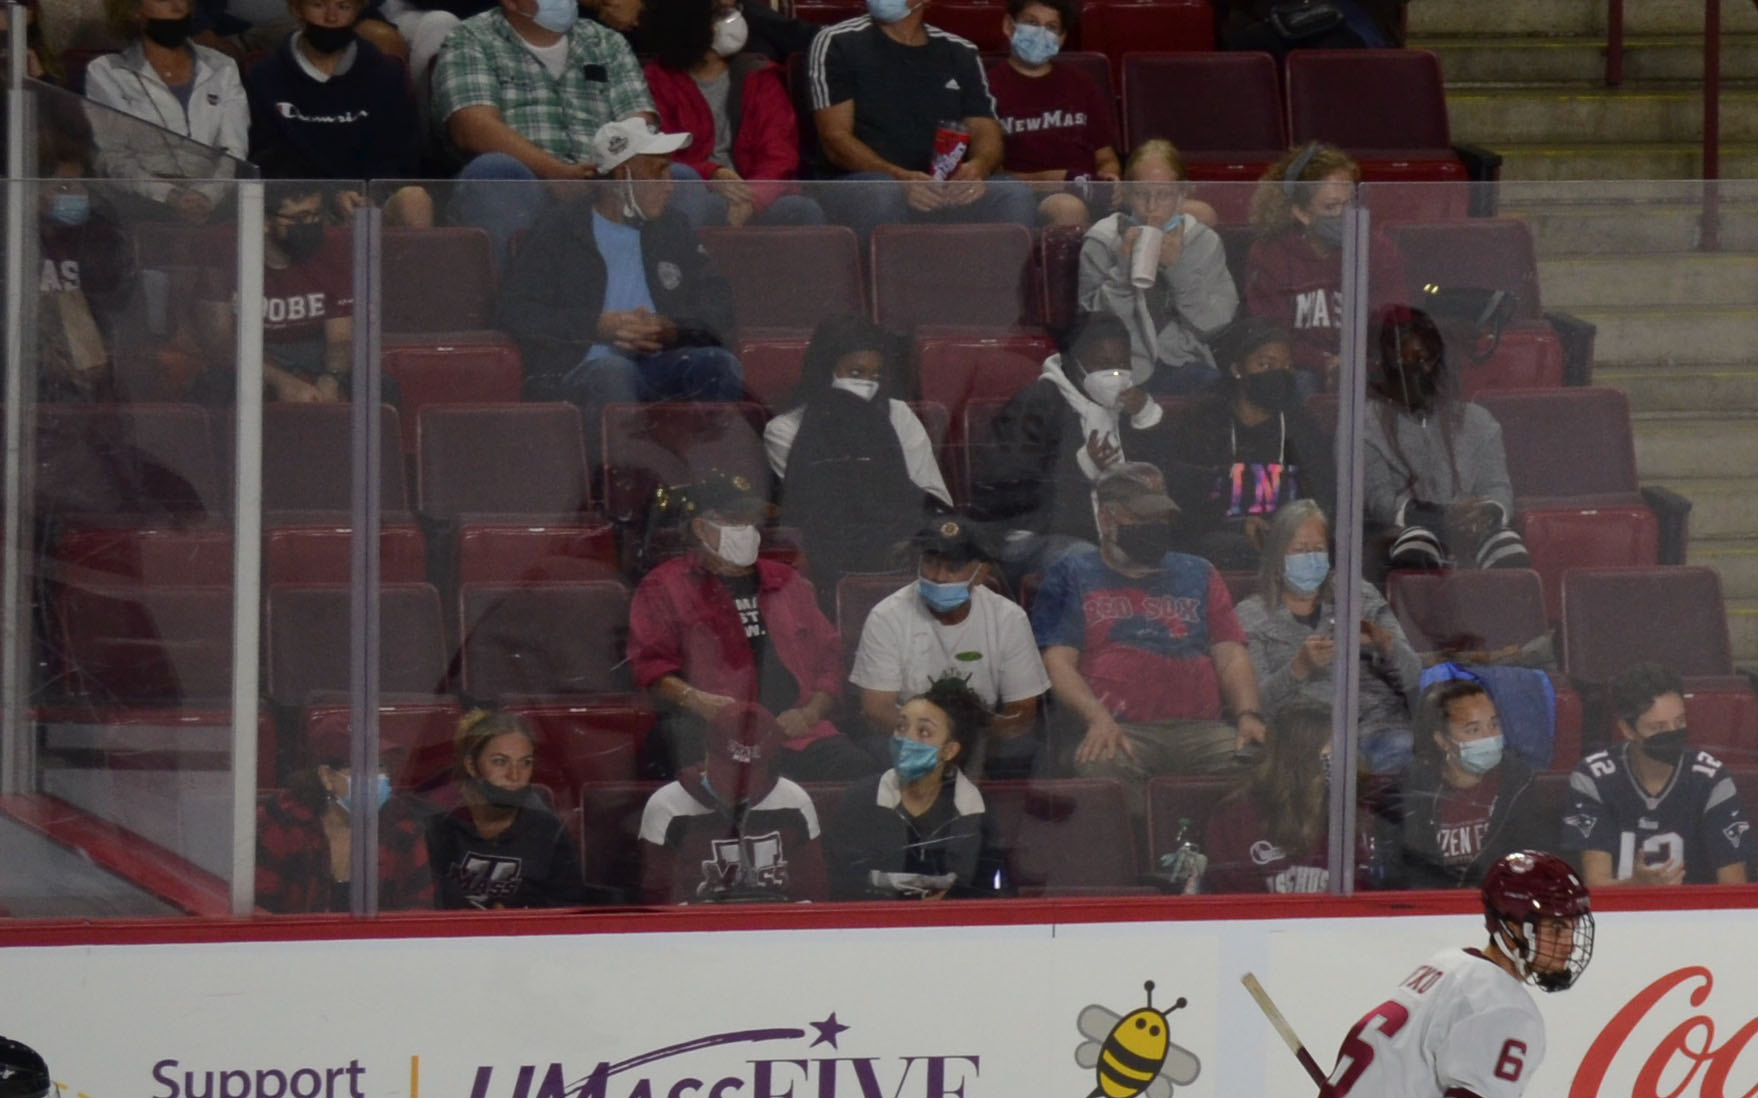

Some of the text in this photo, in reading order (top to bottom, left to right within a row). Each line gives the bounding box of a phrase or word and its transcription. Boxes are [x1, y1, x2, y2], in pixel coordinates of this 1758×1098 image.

[1585, 750, 1617, 778] 12
[1692, 751, 1723, 778] 12
[1494, 1038, 1527, 1082] 6
